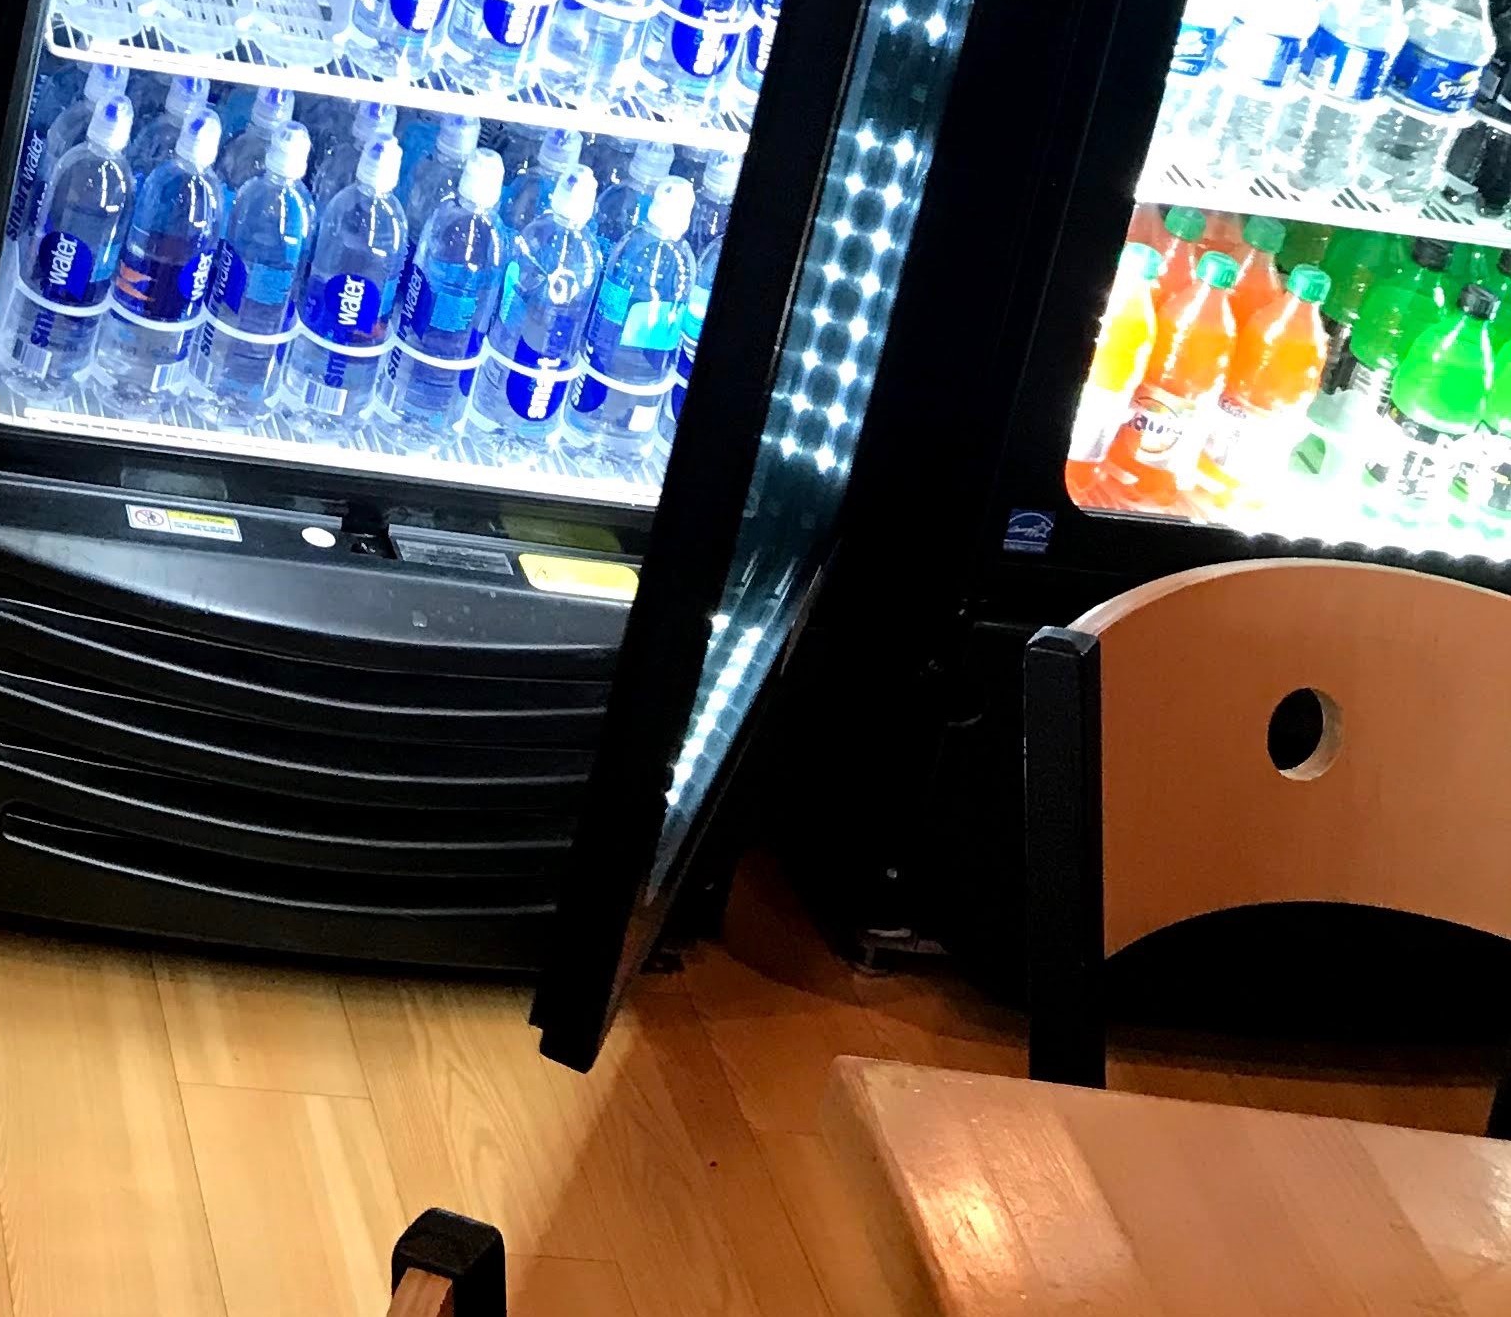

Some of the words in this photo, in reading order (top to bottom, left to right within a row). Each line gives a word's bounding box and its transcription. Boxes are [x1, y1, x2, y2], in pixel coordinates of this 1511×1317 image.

[22, 130, 44, 182] water
[50, 233, 78, 286] water
[191, 250, 214, 302] water
[338, 274, 366, 326] water
[402, 266, 424, 320] water
